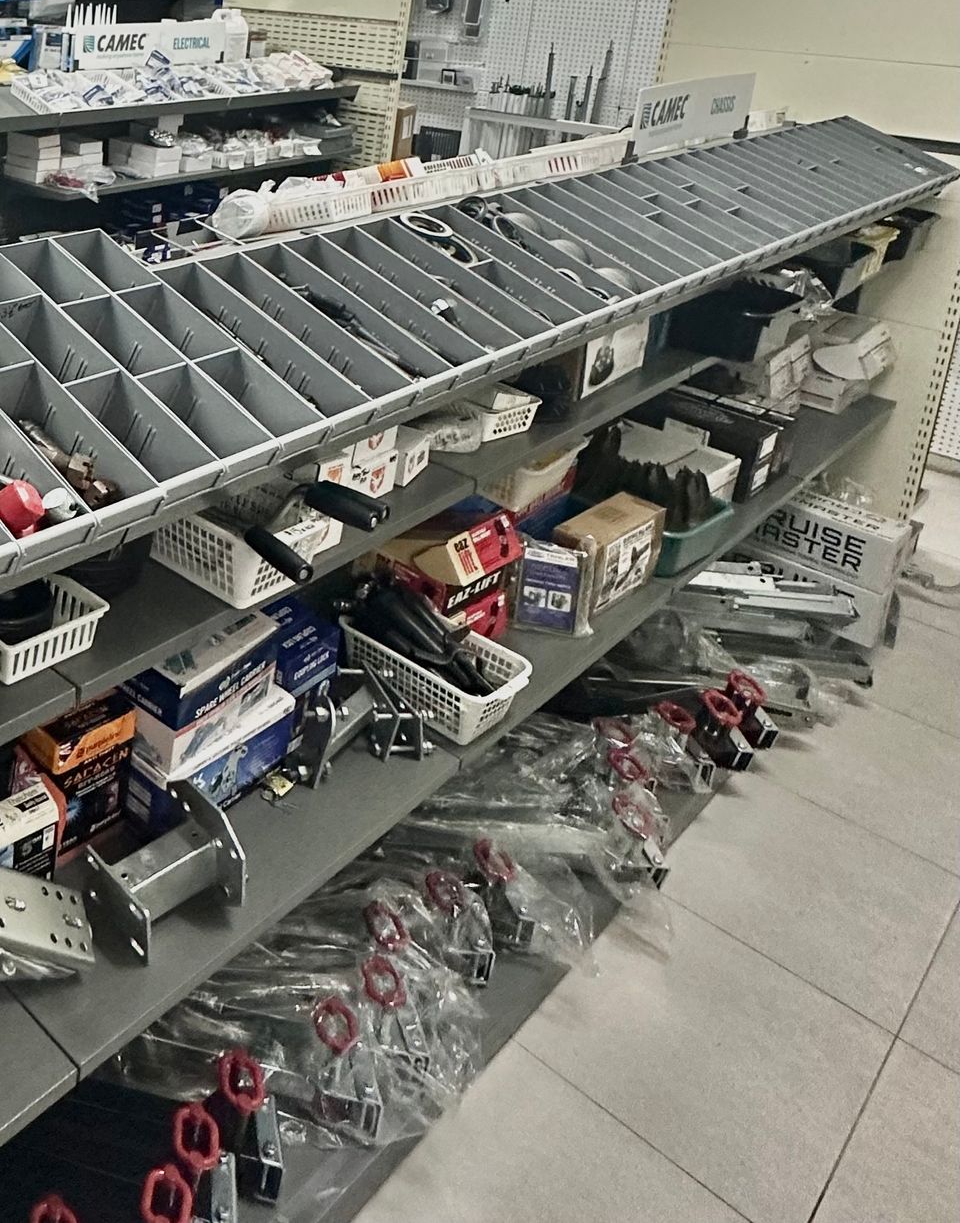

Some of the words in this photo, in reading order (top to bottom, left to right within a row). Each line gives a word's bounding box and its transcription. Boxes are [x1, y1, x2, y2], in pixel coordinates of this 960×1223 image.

[97, 33, 147, 53] CAMEC
[173, 37, 210, 50] ELECTRICAL
[651, 93, 690, 127] CAMEC
[454, 538, 469, 553] eaz
[447, 570, 502, 609] EAZ-LIFT
[195, 695, 218, 719] SPARE
